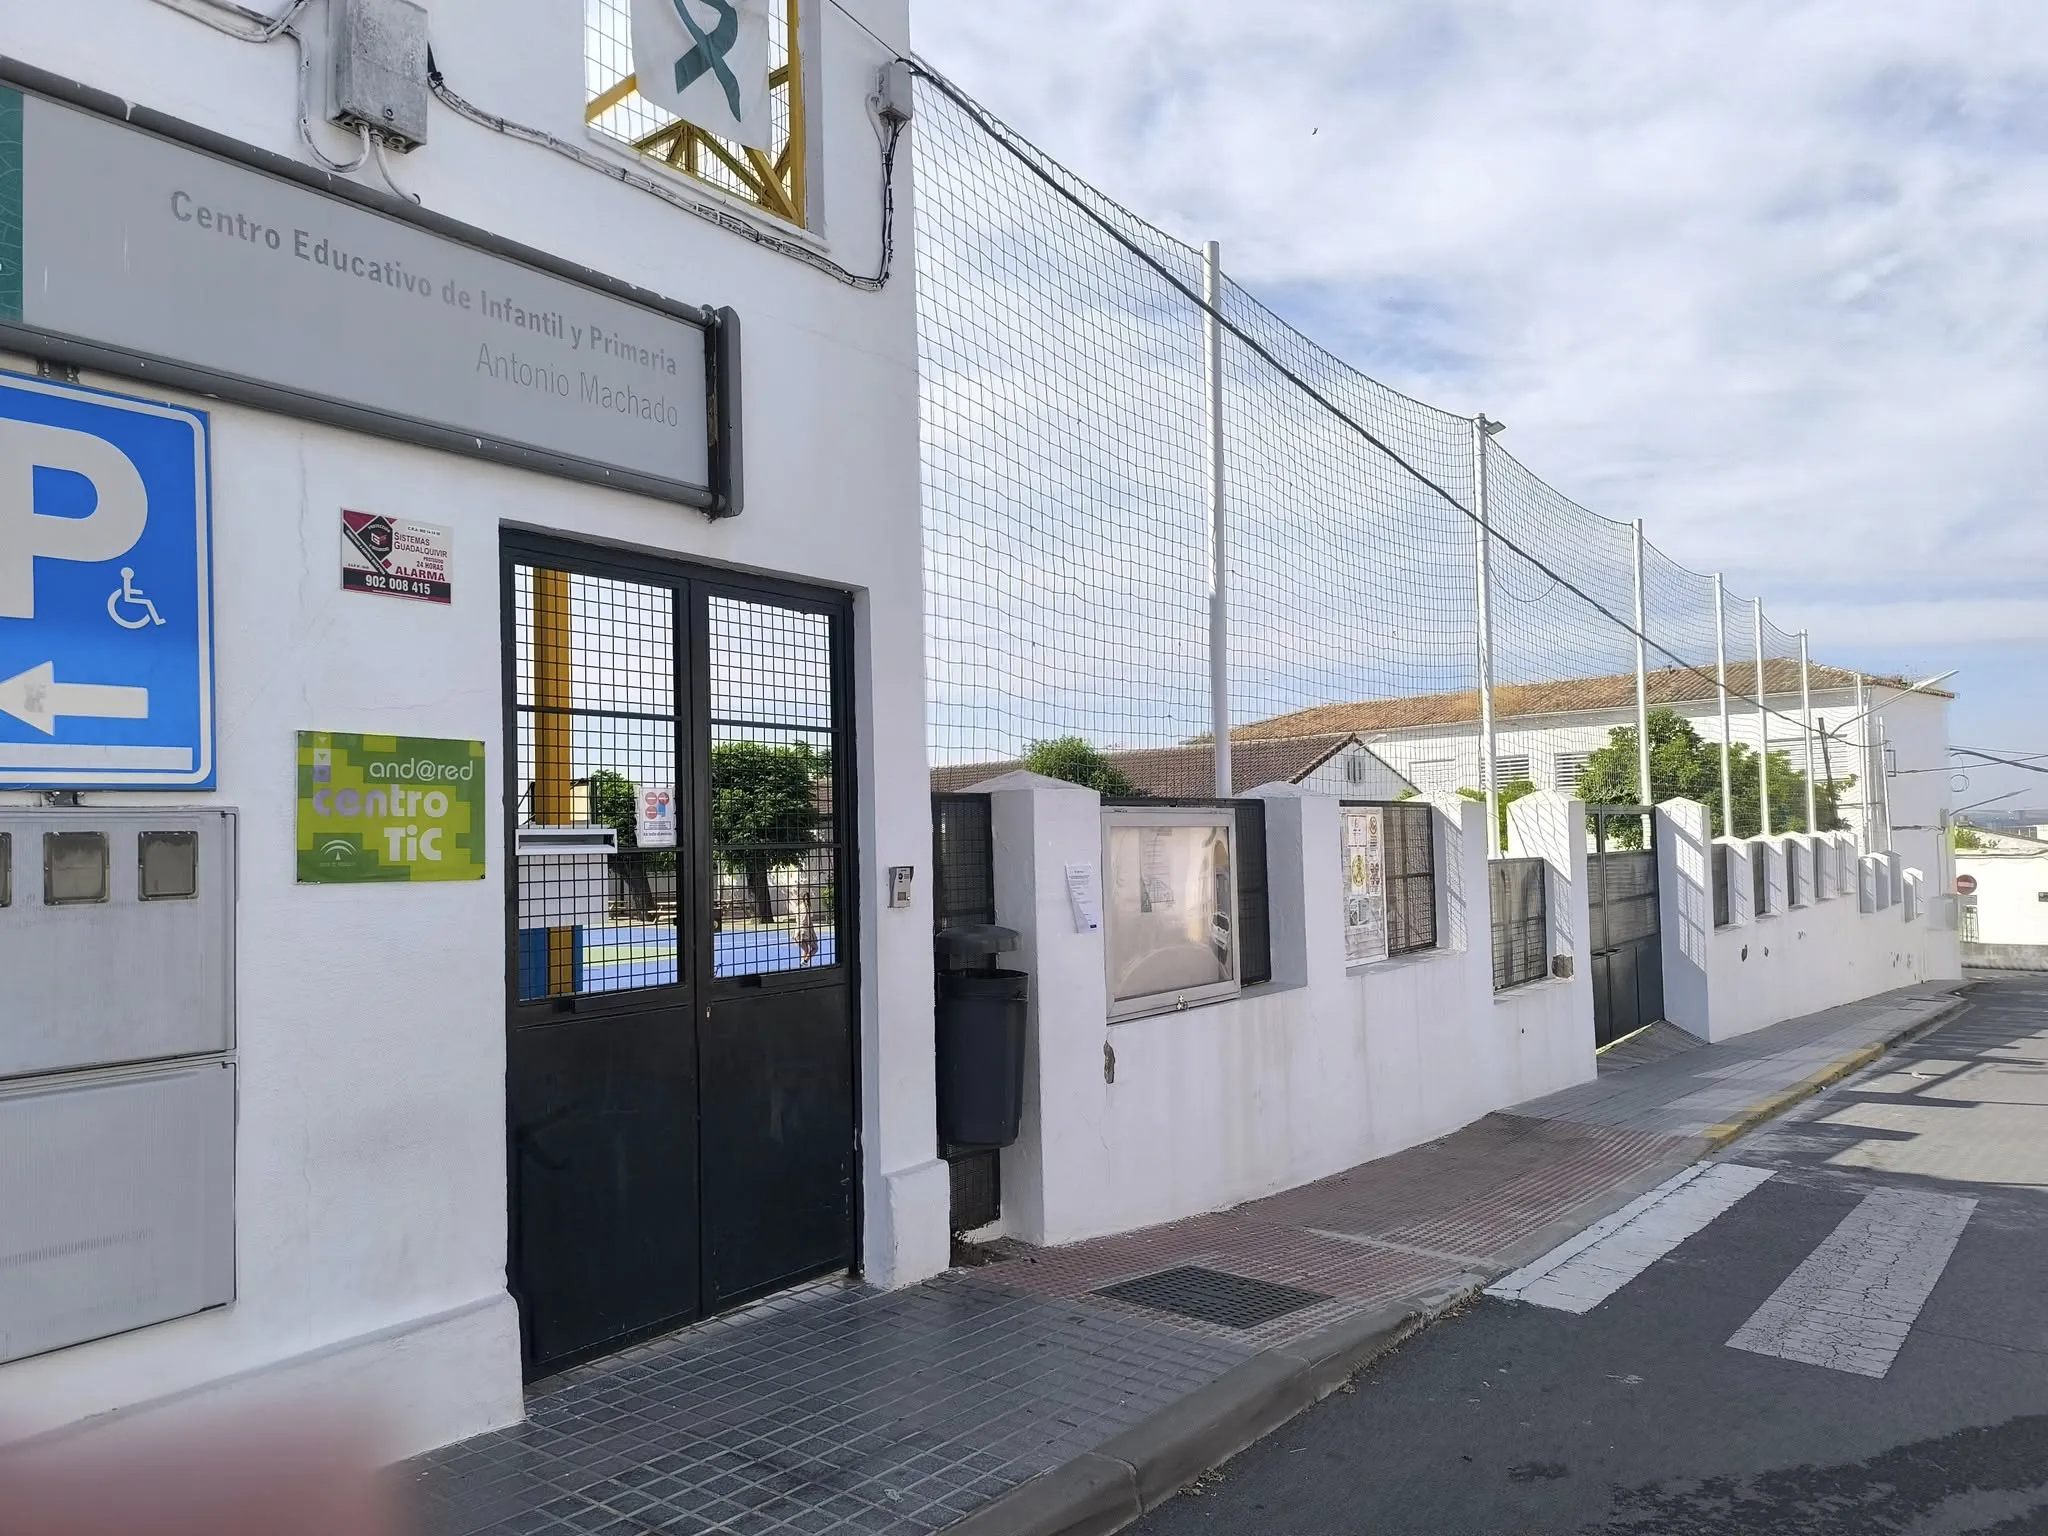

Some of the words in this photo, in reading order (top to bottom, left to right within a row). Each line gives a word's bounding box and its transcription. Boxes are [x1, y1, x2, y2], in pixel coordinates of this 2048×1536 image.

[170, 190, 281, 251] Centro
[293, 228, 432, 297] Educativo
[441, 279, 471, 310] de
[480, 289, 564, 340] Infantil
[570, 325, 582, 350] y
[590, 324, 677, 376] Primaria
[476, 342, 569, 397] Antonio
[579, 370, 678, 428] Machado
[0, 417, 148, 619] P
[393, 541, 448, 558] GUADALQUIVIR
[394, 531, 430, 547] SISTEMAS
[395, 566, 446, 582] ALARMA
[416, 560, 424, 568] 24
[425, 562, 444, 571] HORAS
[365, 574, 386, 588] 902
[389, 577, 409, 592] 008
[411, 581, 431, 595] 415
[369, 757, 474, 781] and@red
[313, 784, 449, 818] centro
[383, 824, 443, 862] TiC
